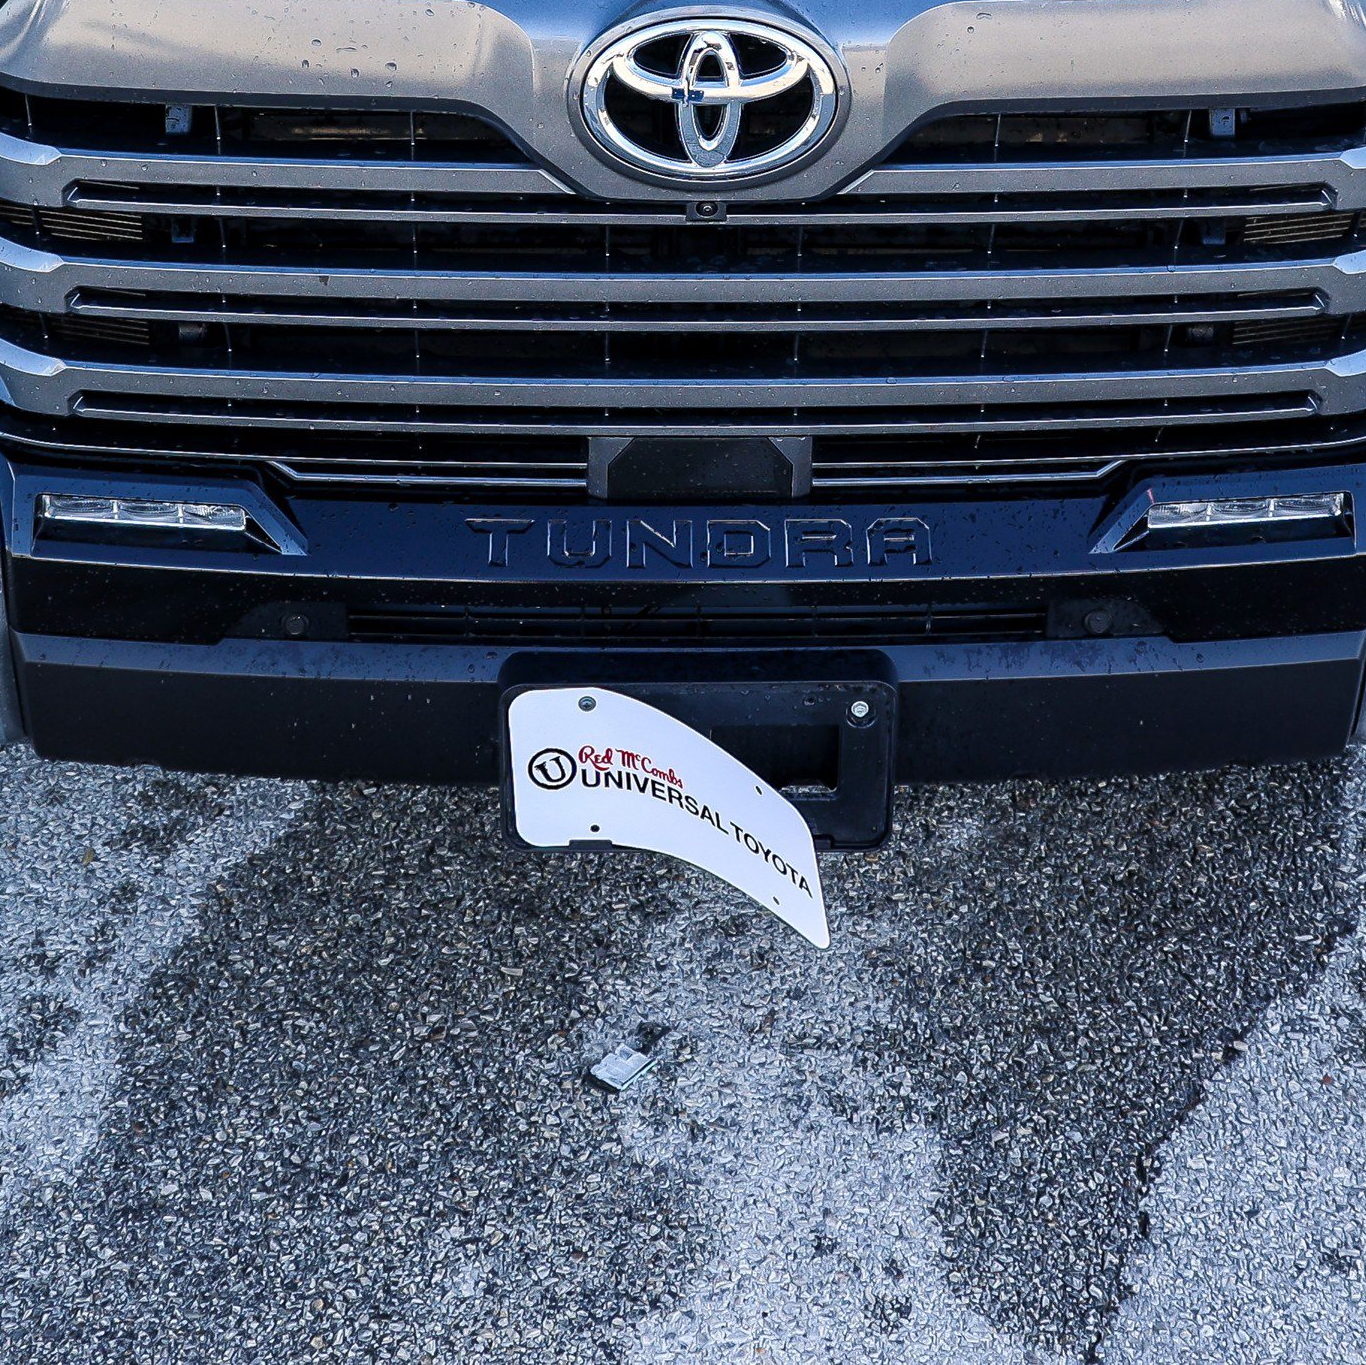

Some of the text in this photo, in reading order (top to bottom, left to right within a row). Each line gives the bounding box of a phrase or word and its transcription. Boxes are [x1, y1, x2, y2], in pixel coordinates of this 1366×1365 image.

[464, 517, 934, 569] TUNDRA
[578, 745, 684, 789] Red McCombs
[581, 768, 814, 899] UNIVERSAL TOYOTA
